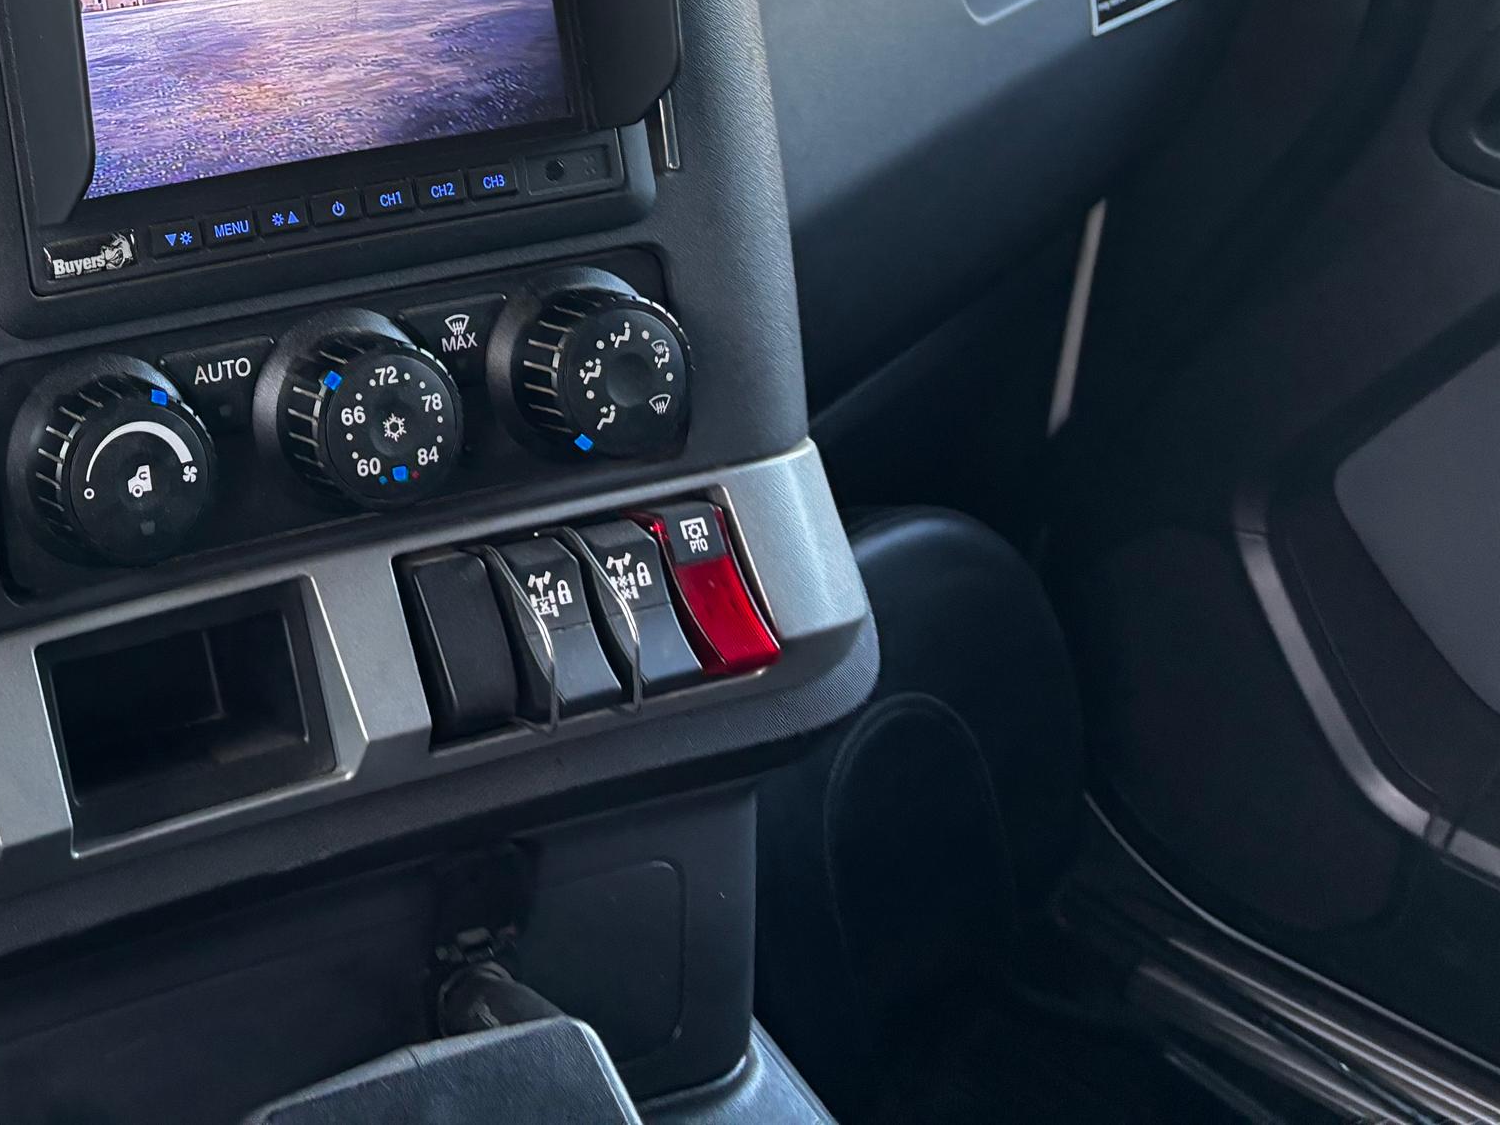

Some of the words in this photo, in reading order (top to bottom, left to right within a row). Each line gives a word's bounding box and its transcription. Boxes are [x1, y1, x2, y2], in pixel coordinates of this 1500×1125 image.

[430, 182, 456, 199] CH2
[482, 174, 506, 189] CH3
[379, 190, 403, 208] CH1
[214, 220, 249, 239] MENU
[52, 254, 106, 277] Buyers
[441, 332, 478, 353] MAX
[194, 357, 252, 386] AUTO
[375, 366, 399, 386] 72
[421, 393, 443, 412] 78
[340, 406, 366, 426] 66
[417, 445, 440, 466] 84
[356, 457, 381, 477] 60
[689, 537, 709, 554] PTO
